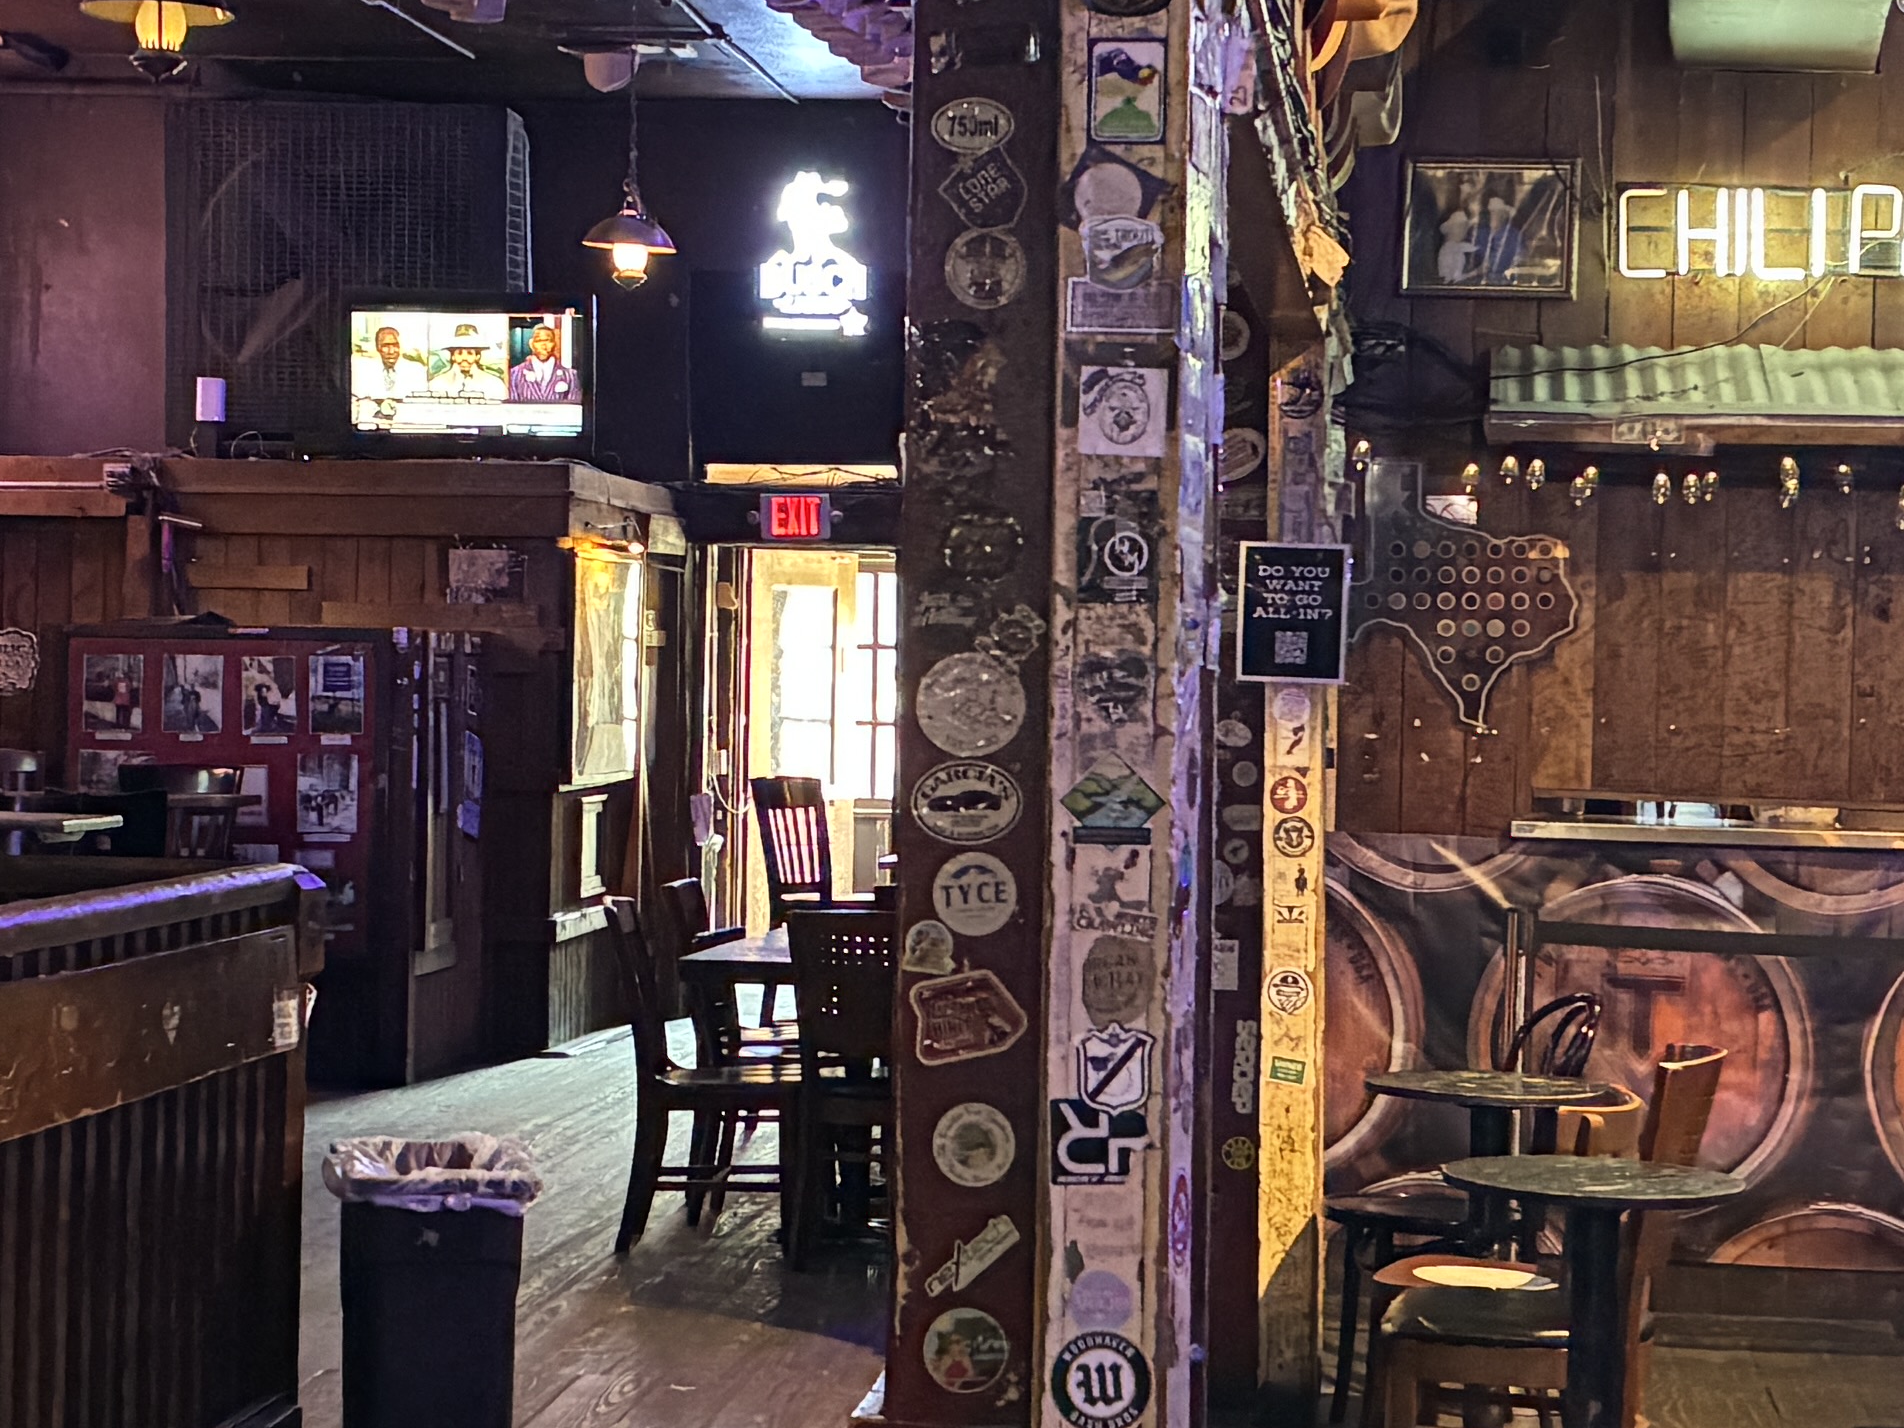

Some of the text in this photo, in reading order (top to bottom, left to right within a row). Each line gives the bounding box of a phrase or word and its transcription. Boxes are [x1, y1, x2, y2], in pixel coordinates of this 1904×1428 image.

[957, 160, 1004, 202] LONE
[968, 174, 1013, 214] STAR
[1619, 187, 1828, 281] CHILI
[771, 496, 822, 536] EXIT
[1258, 565, 1330, 578] DO YOU
[1265, 579, 1323, 591] WANT
[1262, 593, 1322, 605] TO GO
[941, 880, 1009, 908] TYCE
[1075, 1361, 1124, 1408] W
